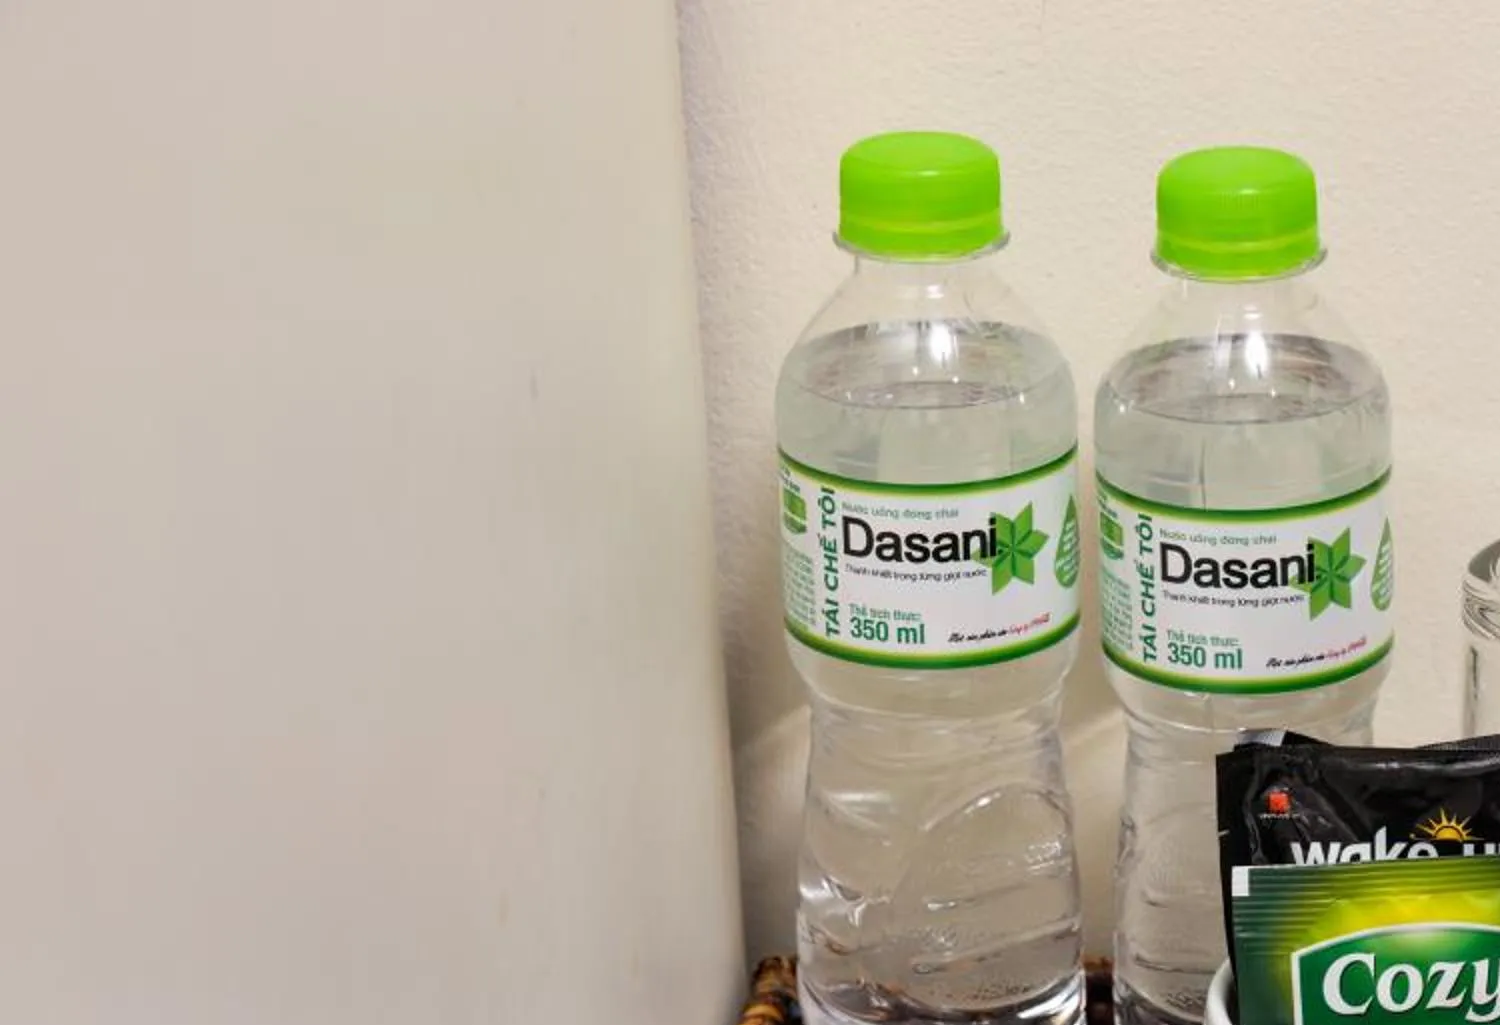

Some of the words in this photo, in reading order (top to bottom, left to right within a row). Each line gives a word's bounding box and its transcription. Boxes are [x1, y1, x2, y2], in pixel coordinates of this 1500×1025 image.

[818, 486, 837, 530] TÔI
[842, 514, 996, 563] Dasani
[1134, 513, 1153, 556] TÔI
[1160, 542, 1314, 589] Dasani
[850, 616, 889, 642] 350
[897, 623, 925, 644] ml
[1168, 642, 1206, 668] 350
[1215, 648, 1242, 669] ml
